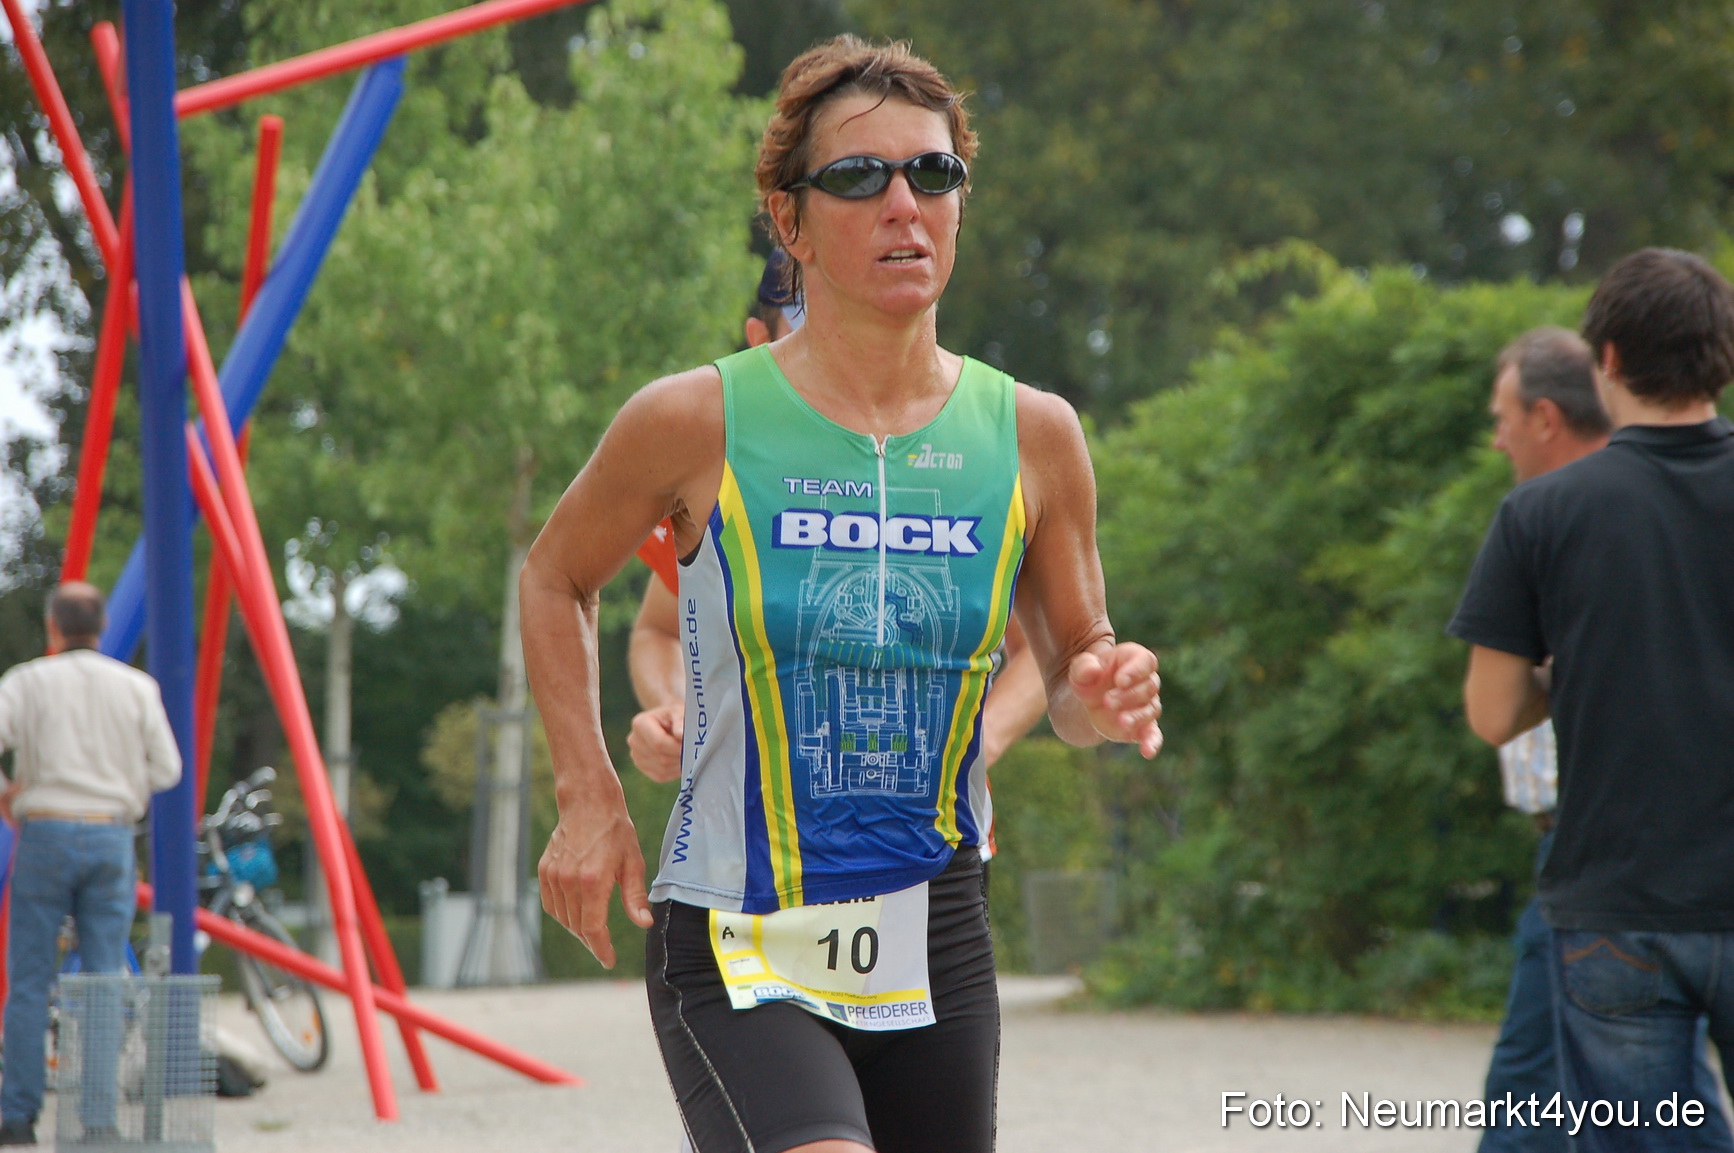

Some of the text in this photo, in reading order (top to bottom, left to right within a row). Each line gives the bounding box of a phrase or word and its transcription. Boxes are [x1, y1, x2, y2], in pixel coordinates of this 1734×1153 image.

[782, 476, 874, 498] TEAM
[772, 508, 984, 557] BOCK
[721, 926, 735, 940] A
[817, 926, 879, 974] 10
[847, 1001, 929, 1019] PFLEIDERER
